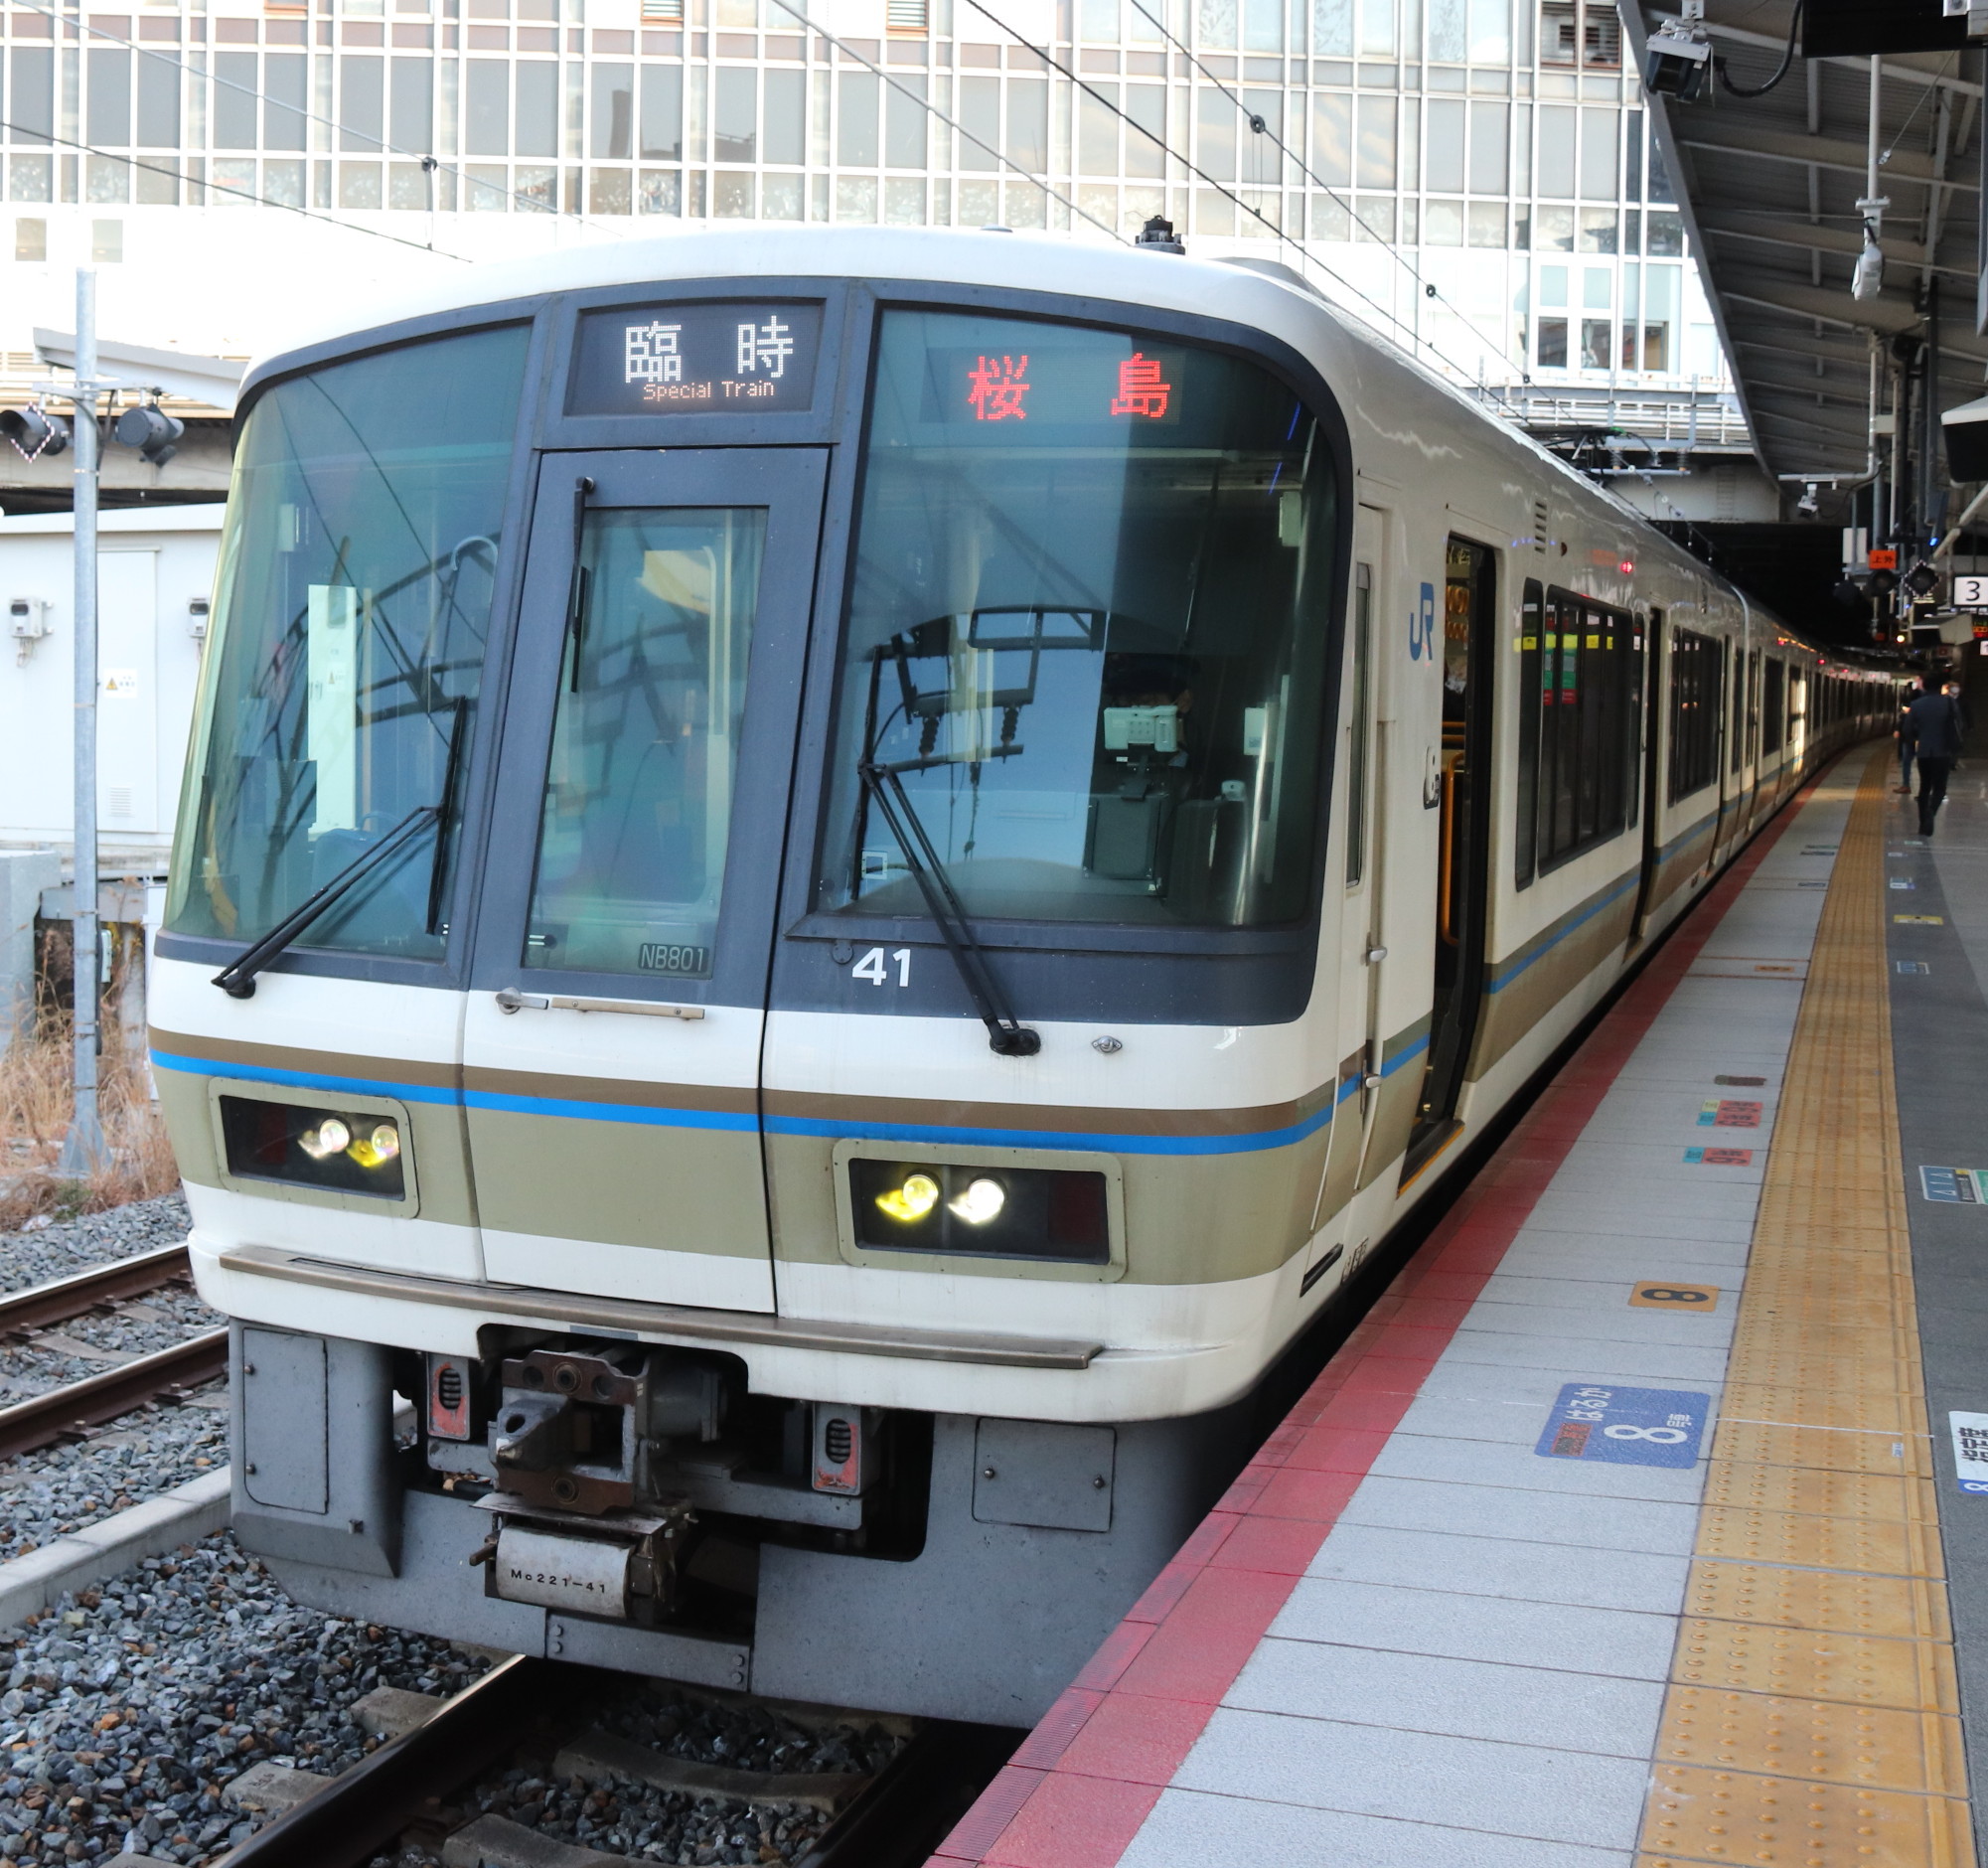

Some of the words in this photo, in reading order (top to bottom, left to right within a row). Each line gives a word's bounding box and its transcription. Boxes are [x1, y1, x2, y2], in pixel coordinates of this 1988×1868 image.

[625, 315, 793, 384] 臨時
[643, 382, 711, 401] Special
[721, 380, 775, 397] Train
[968, 353, 1170, 420] 桜島
[1965, 580, 1980, 601] 3
[1409, 581, 1435, 661] JR
[641, 943, 704, 971] NB801
[851, 947, 911, 987] 41
[1640, 1288, 1709, 1303] 8
[1564, 1387, 1612, 1421] はるか
